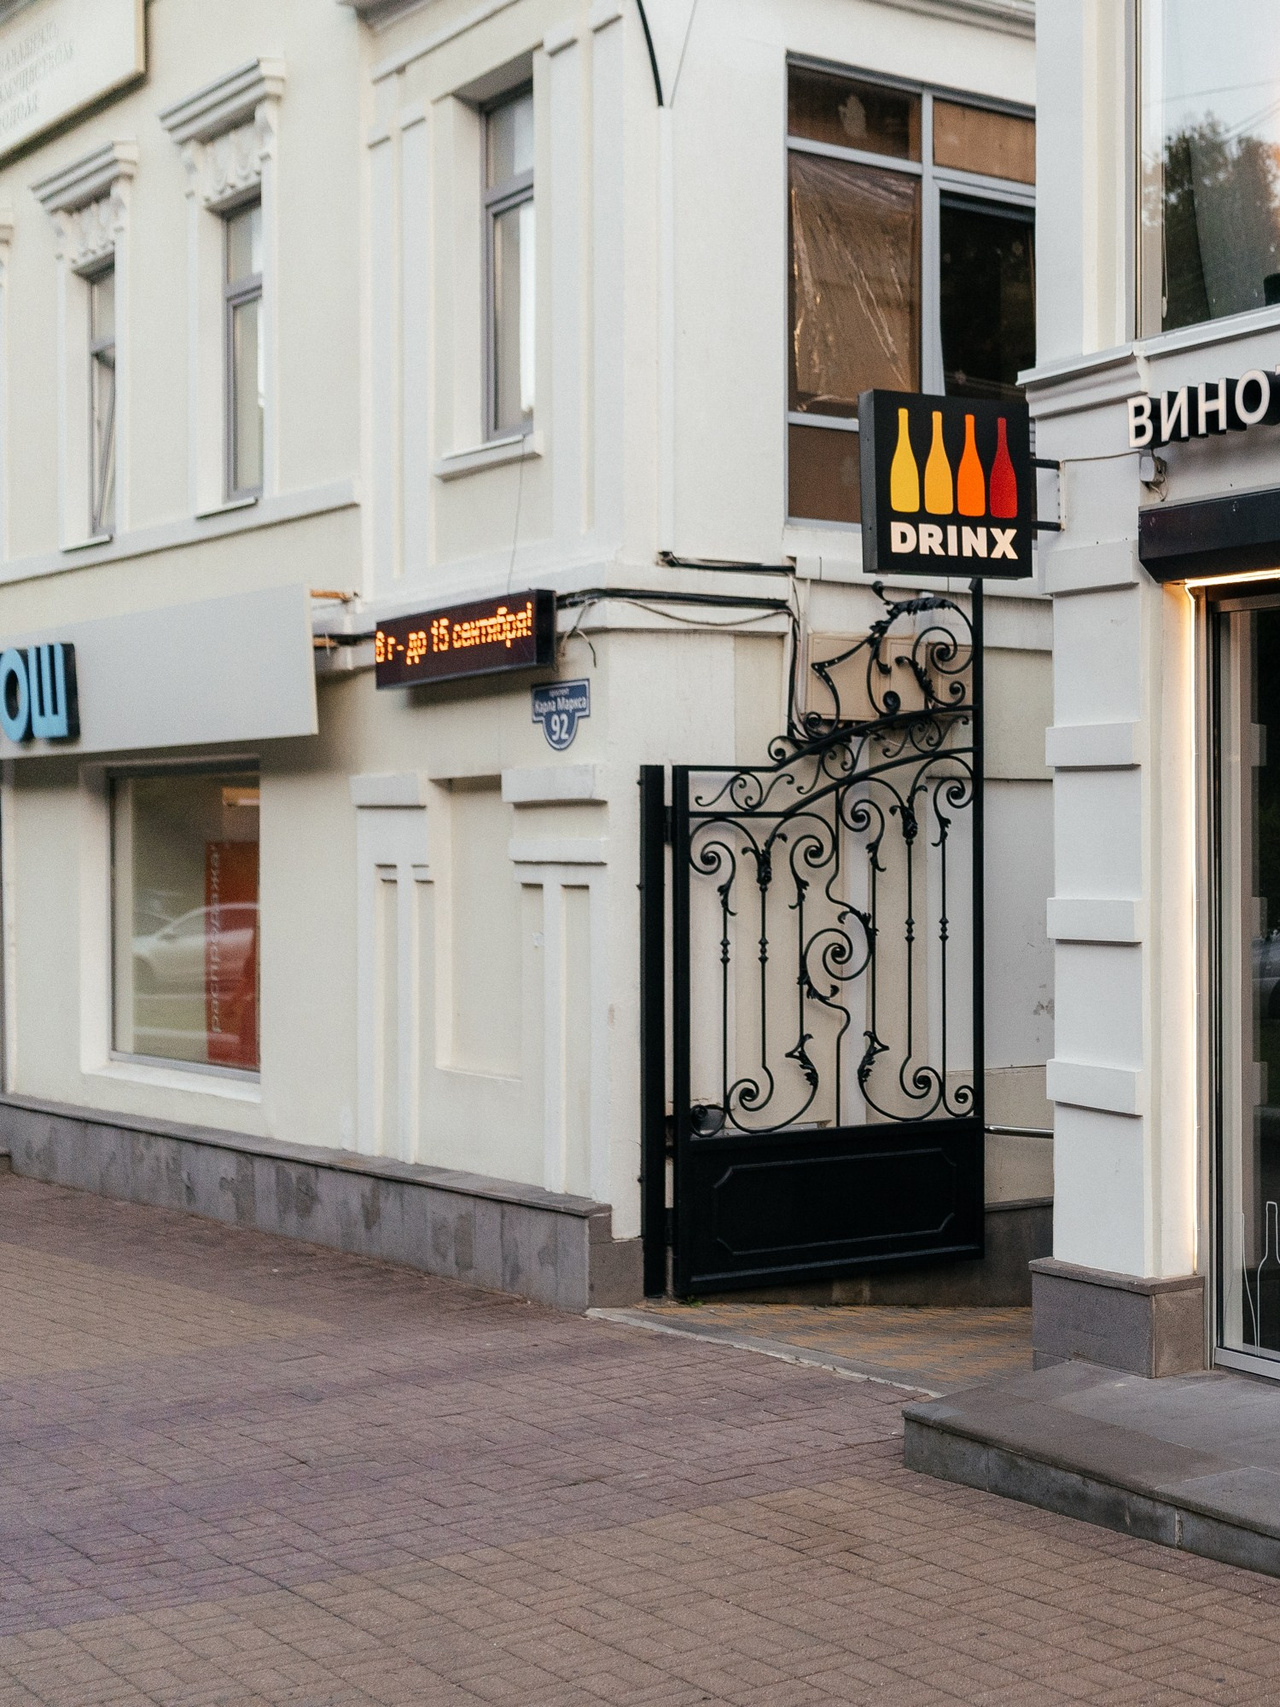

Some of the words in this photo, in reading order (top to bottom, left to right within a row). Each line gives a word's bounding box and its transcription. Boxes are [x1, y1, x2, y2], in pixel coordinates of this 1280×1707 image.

[890, 521, 1019, 560] DRINX
[430, 617, 449, 653] 15
[452, 601, 532, 648] сентября!
[551, 713, 569, 741] 92
